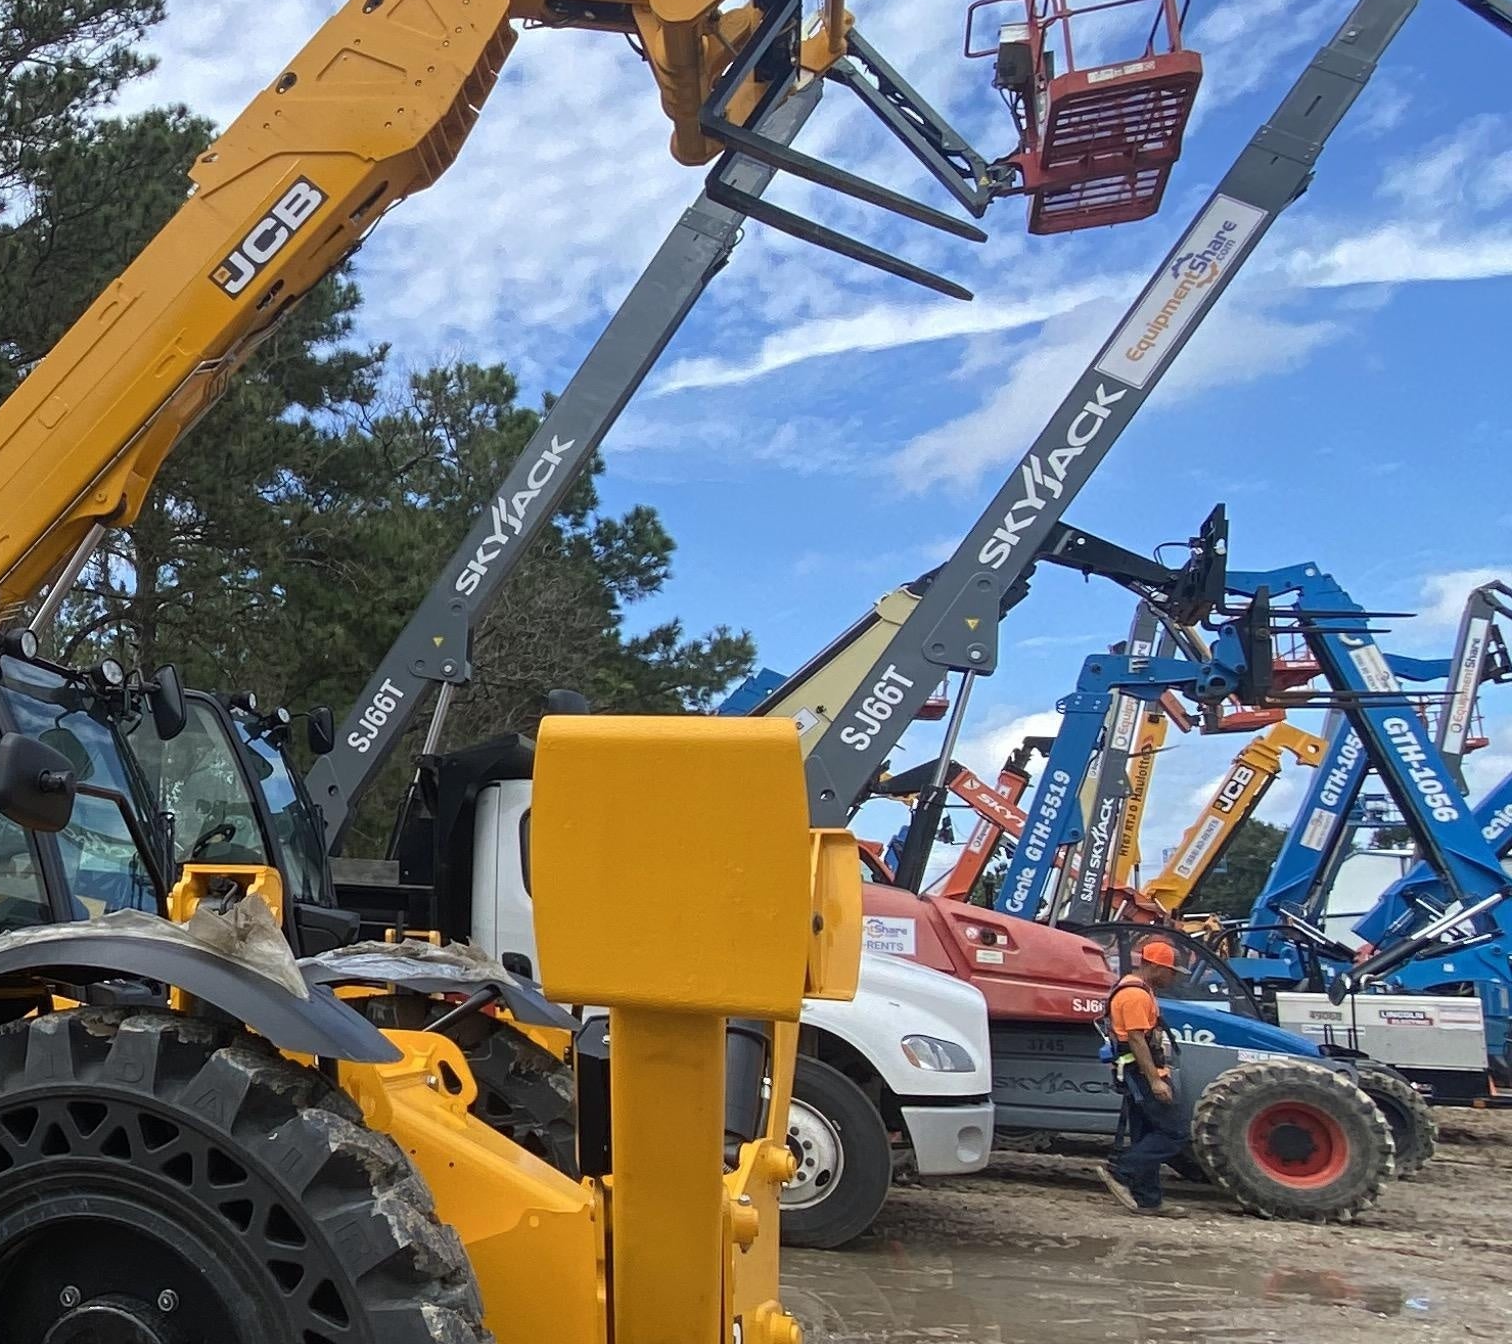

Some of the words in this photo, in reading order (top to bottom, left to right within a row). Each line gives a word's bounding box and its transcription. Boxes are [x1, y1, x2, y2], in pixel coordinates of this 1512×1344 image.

[224, 181, 324, 294] JCB
[1126, 220, 1237, 361] EquipmentShare
[455, 434, 576, 595] SKYJACK
[978, 383, 1128, 569] SKYJACK
[347, 678, 405, 753] SJ66T
[840, 664, 914, 751] SJ66T
[1218, 766, 1255, 813] JCB
[1383, 717, 1459, 822] GTH-1056
[1006, 867, 1037, 913] Genie
[1025, 770, 1071, 862] GTH-5519
[1090, 798, 1115, 869] SKYJACK
